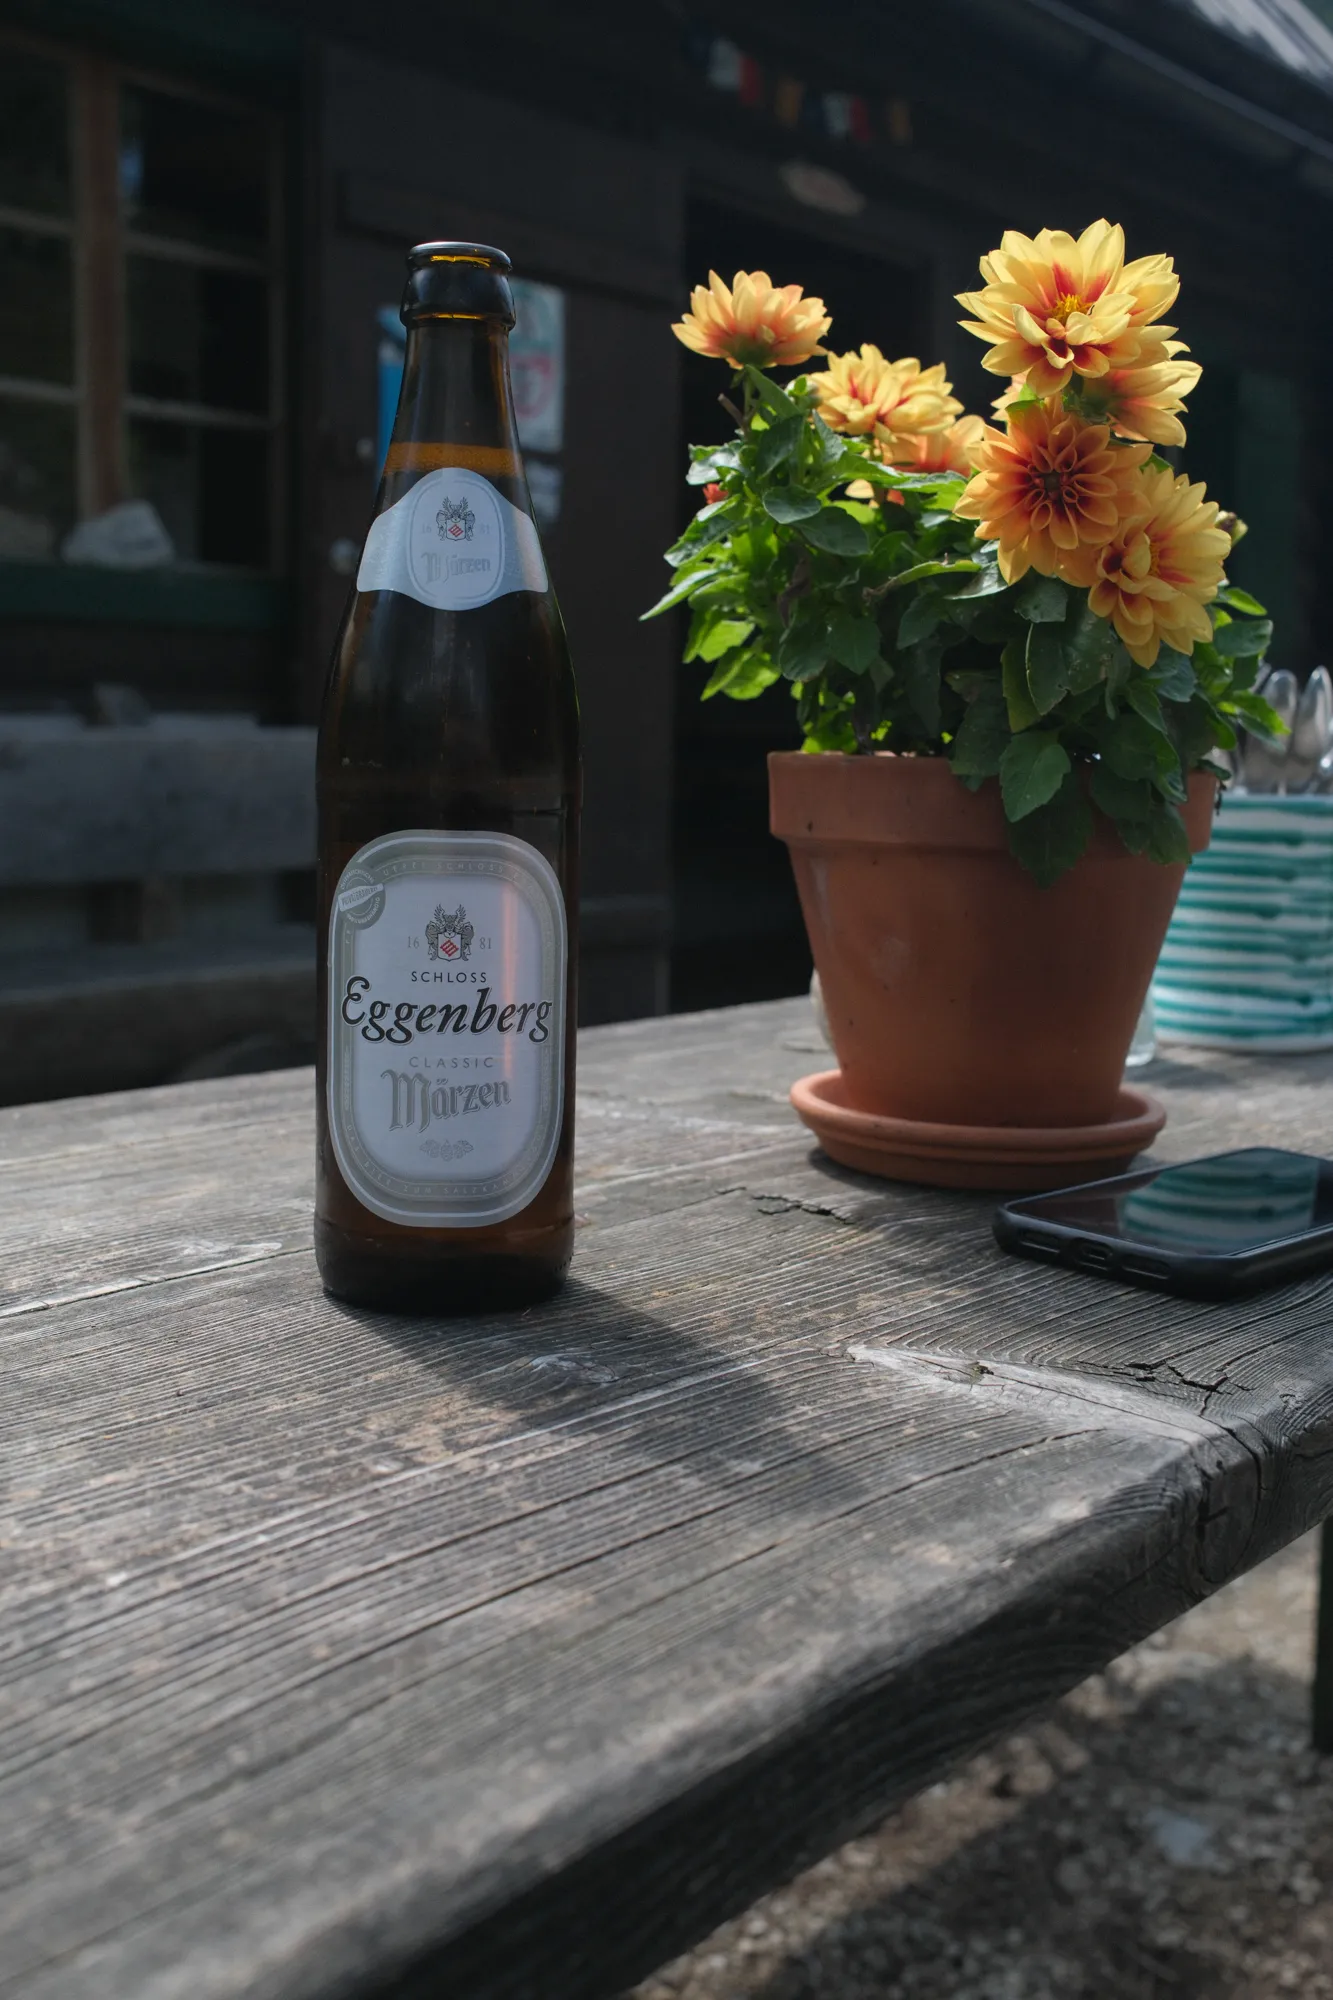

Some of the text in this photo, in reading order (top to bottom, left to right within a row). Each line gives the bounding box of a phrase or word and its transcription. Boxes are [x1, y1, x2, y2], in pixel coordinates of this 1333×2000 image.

[407, 935, 492, 950] 16 81
[411, 971, 487, 983] SCHLOSS
[341, 975, 553, 1044] Eggenberg
[409, 1057, 494, 1069] CLASSIC
[380, 1069, 512, 1133] Märzen
